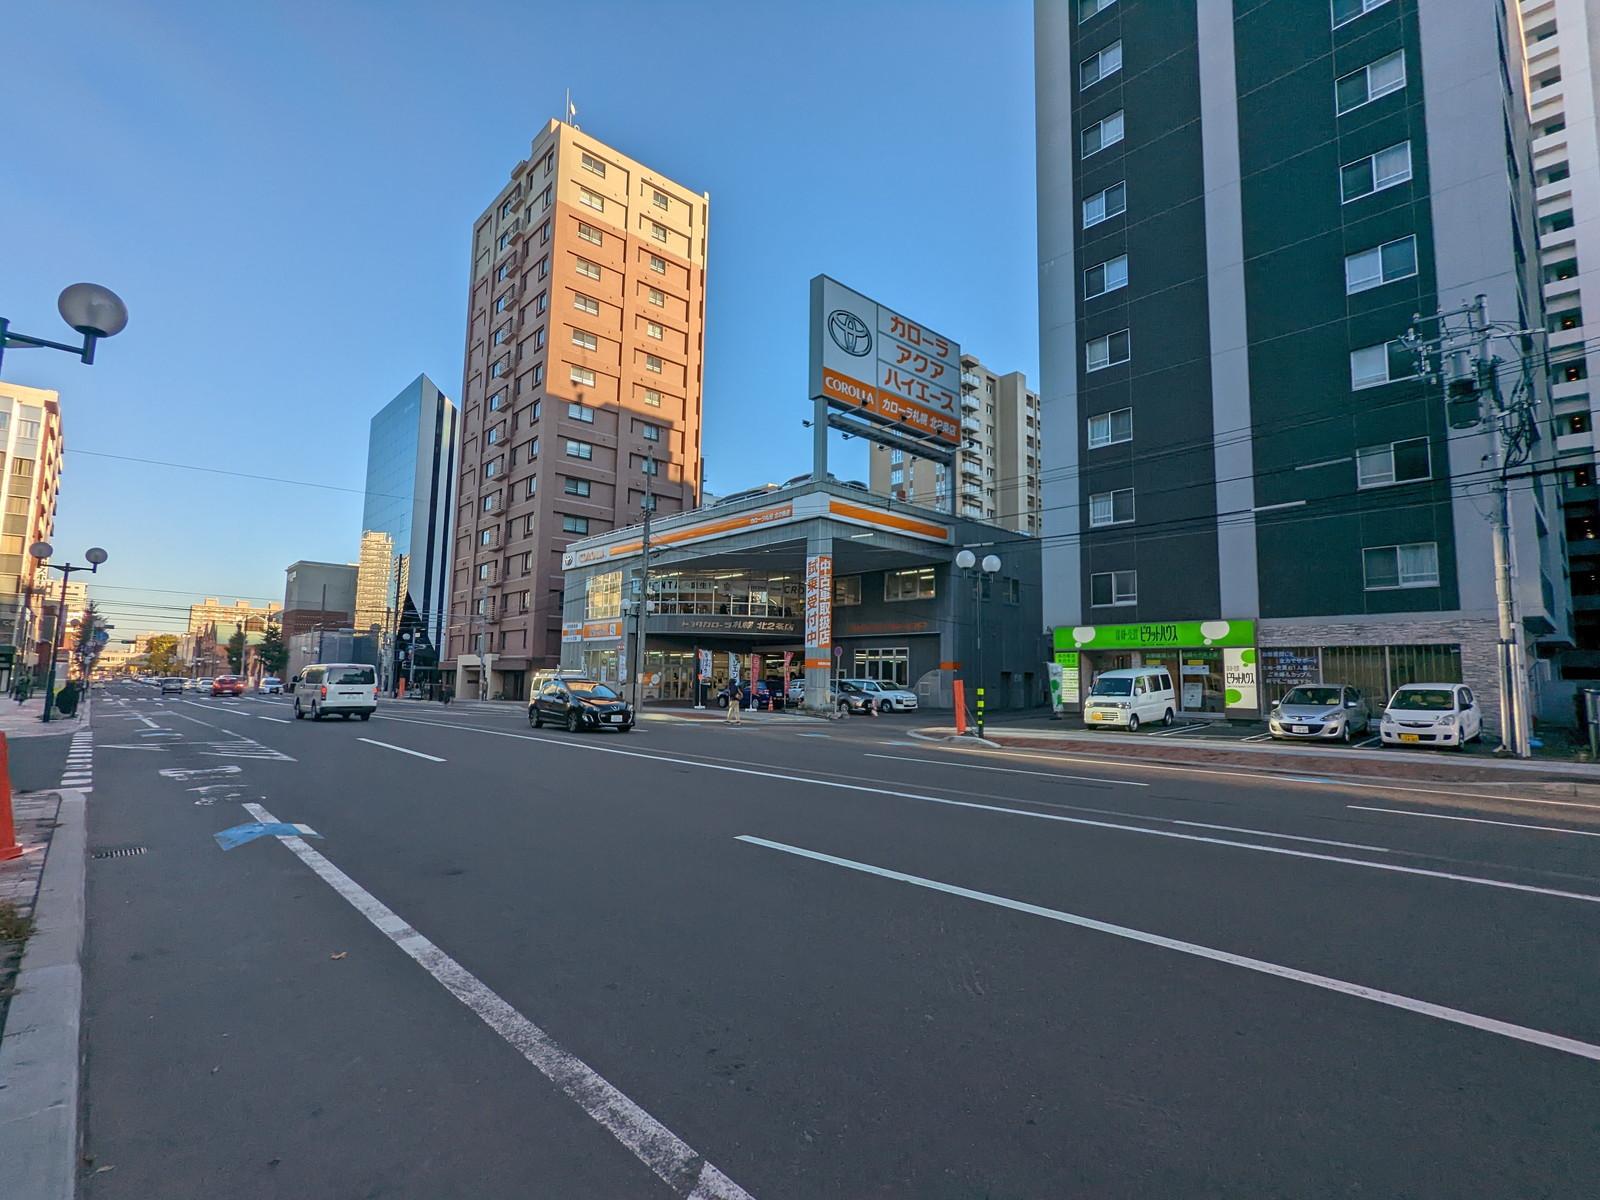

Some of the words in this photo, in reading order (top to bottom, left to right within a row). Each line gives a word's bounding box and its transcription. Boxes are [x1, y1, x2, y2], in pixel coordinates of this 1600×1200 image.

[890, 316, 949, 358] カローラ
[895, 344, 945, 378] アクア
[825, 376, 874, 405] COROLLA
[884, 368, 955, 413] ハイエース
[881, 398, 929, 426] カローラ札幌
[806, 559, 818, 645] 試乗受付中
[819, 558, 831, 645] 中古車取扱店
[1140, 624, 1178, 642] ピタットハウス
[1226, 672, 1255, 684] ピタットハウス
